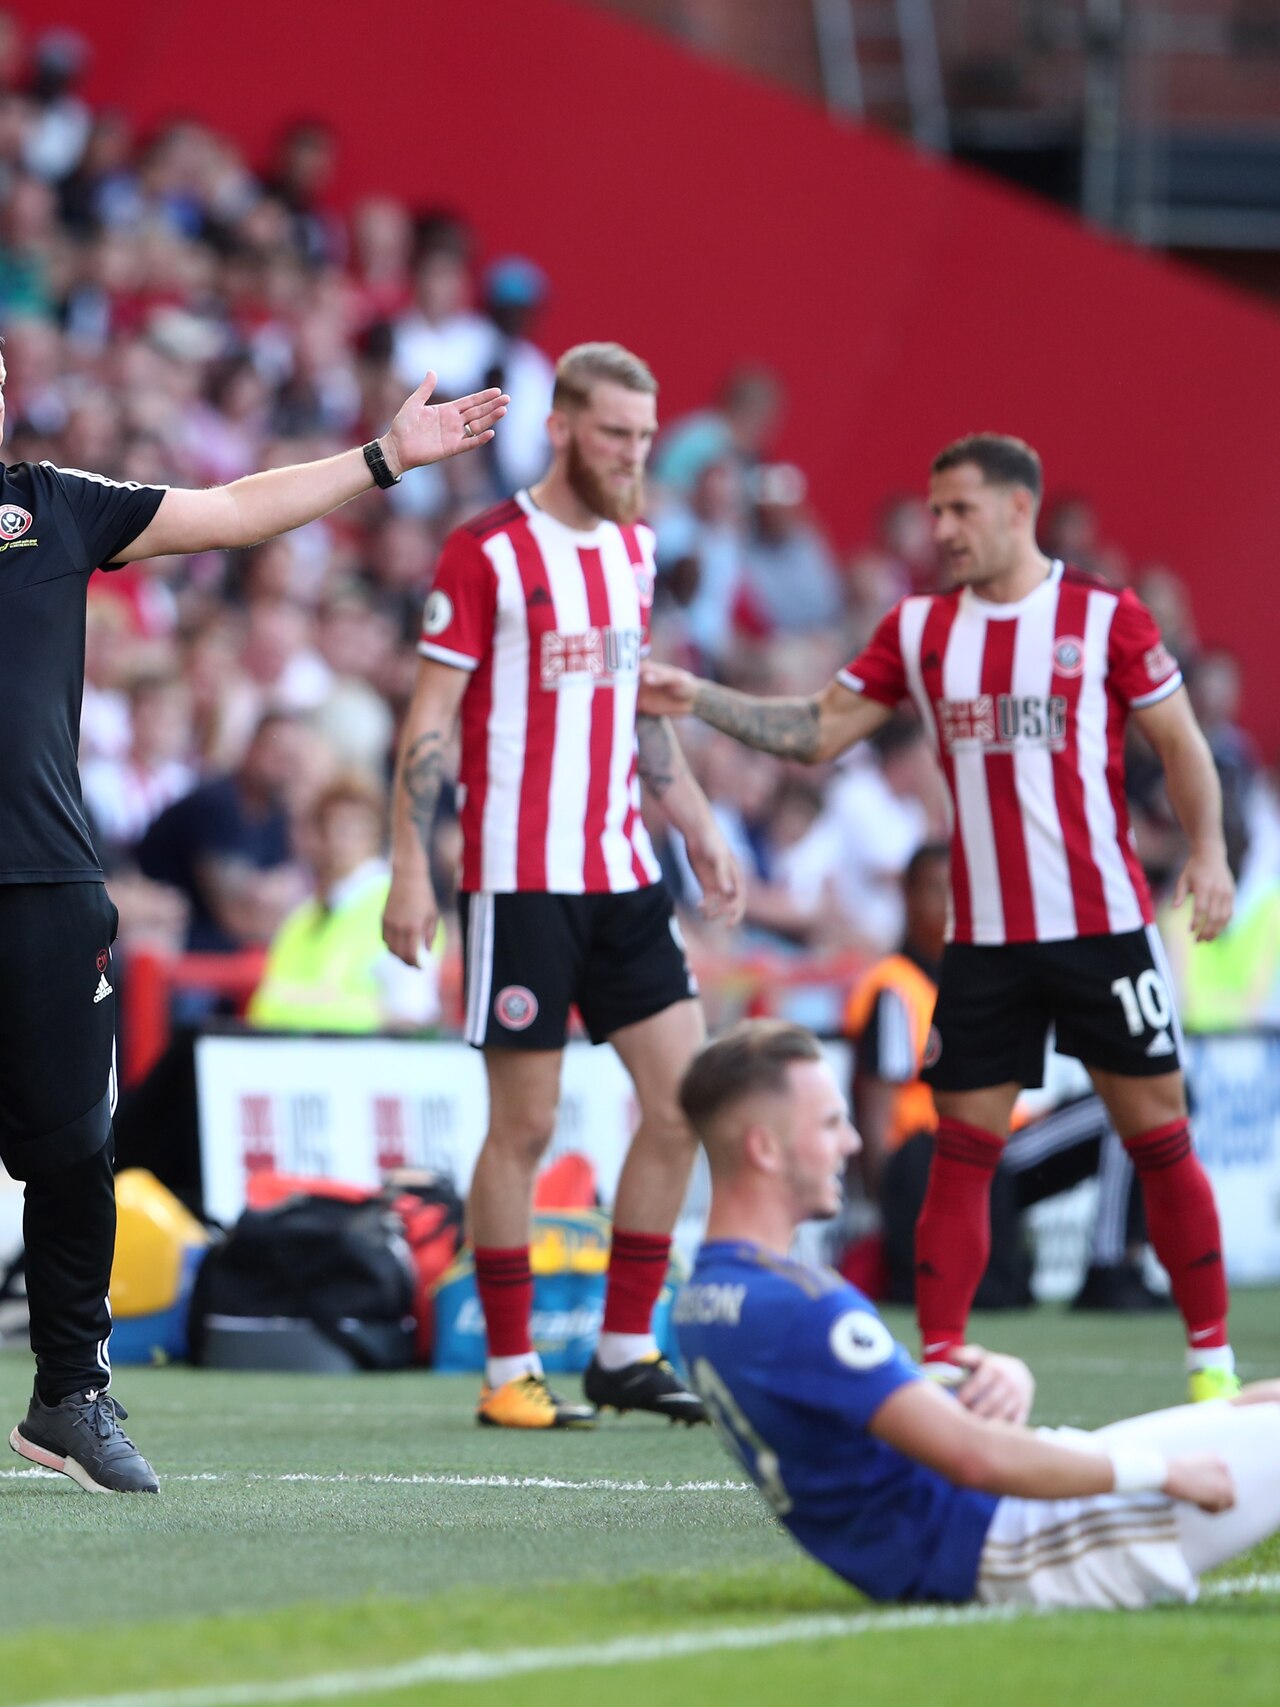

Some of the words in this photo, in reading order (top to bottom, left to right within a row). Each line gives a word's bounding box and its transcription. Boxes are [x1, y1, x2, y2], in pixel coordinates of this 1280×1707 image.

[997, 693, 1068, 741] USG
[93, 985, 113, 1003] adidas
[1111, 968, 1171, 1037] 10
